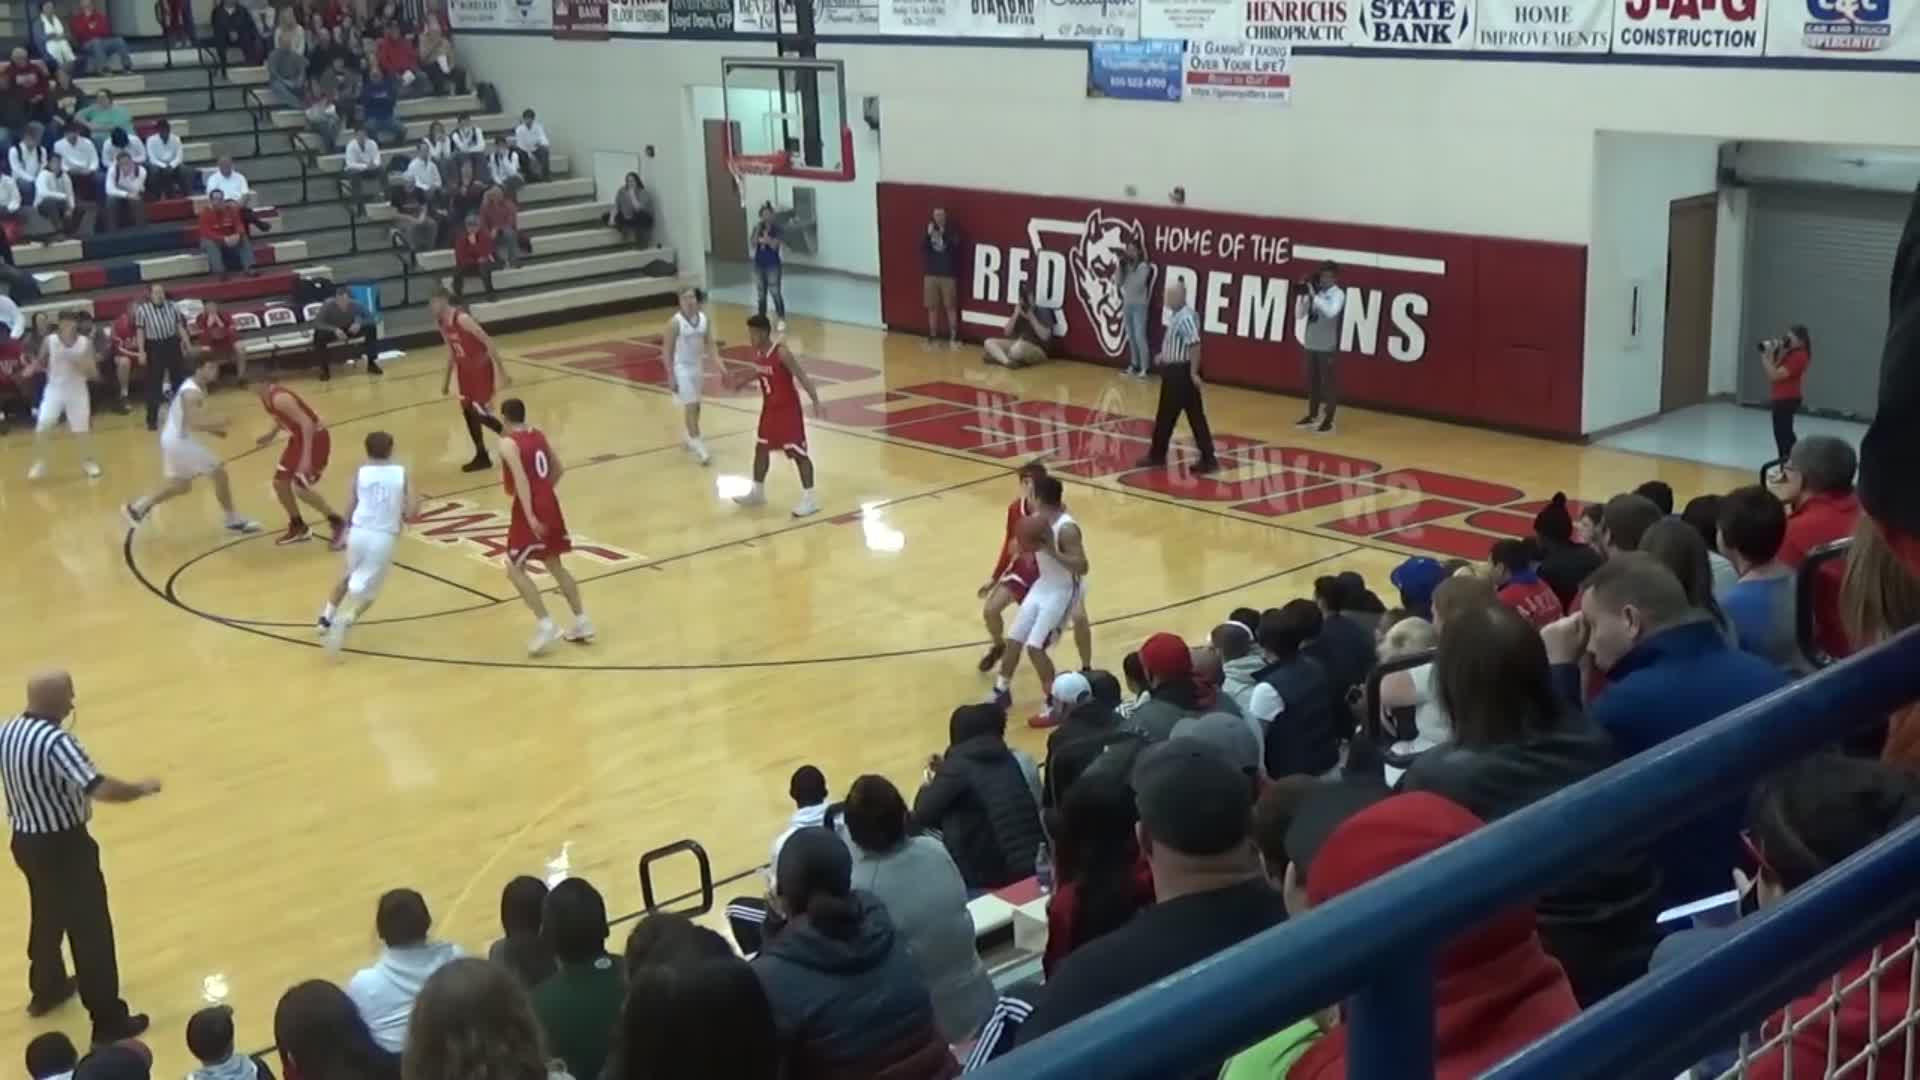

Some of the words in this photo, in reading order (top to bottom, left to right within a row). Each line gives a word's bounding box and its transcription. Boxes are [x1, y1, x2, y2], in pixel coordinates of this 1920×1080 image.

[1246, 0, 1347, 22] HENRICHS
[1370, 0, 1456, 20] STATE
[1515, 6, 1571, 25] HOME
[1245, 24, 1347, 41] CHIROPRACTIC
[1373, 22, 1452, 44] BANK
[1480, 30, 1608, 48] IMPROVEMENTS
[1621, 28, 1758, 48] CONSTRUCTION
[1155, 224, 1213, 258] HOME
[1218, 233, 1244, 260] OF
[1250, 235, 1291, 264] THE
[973, 243, 1067, 308] RED
[1163, 264, 1430, 363] DEMNS
[535, 449, 548, 478] 0
